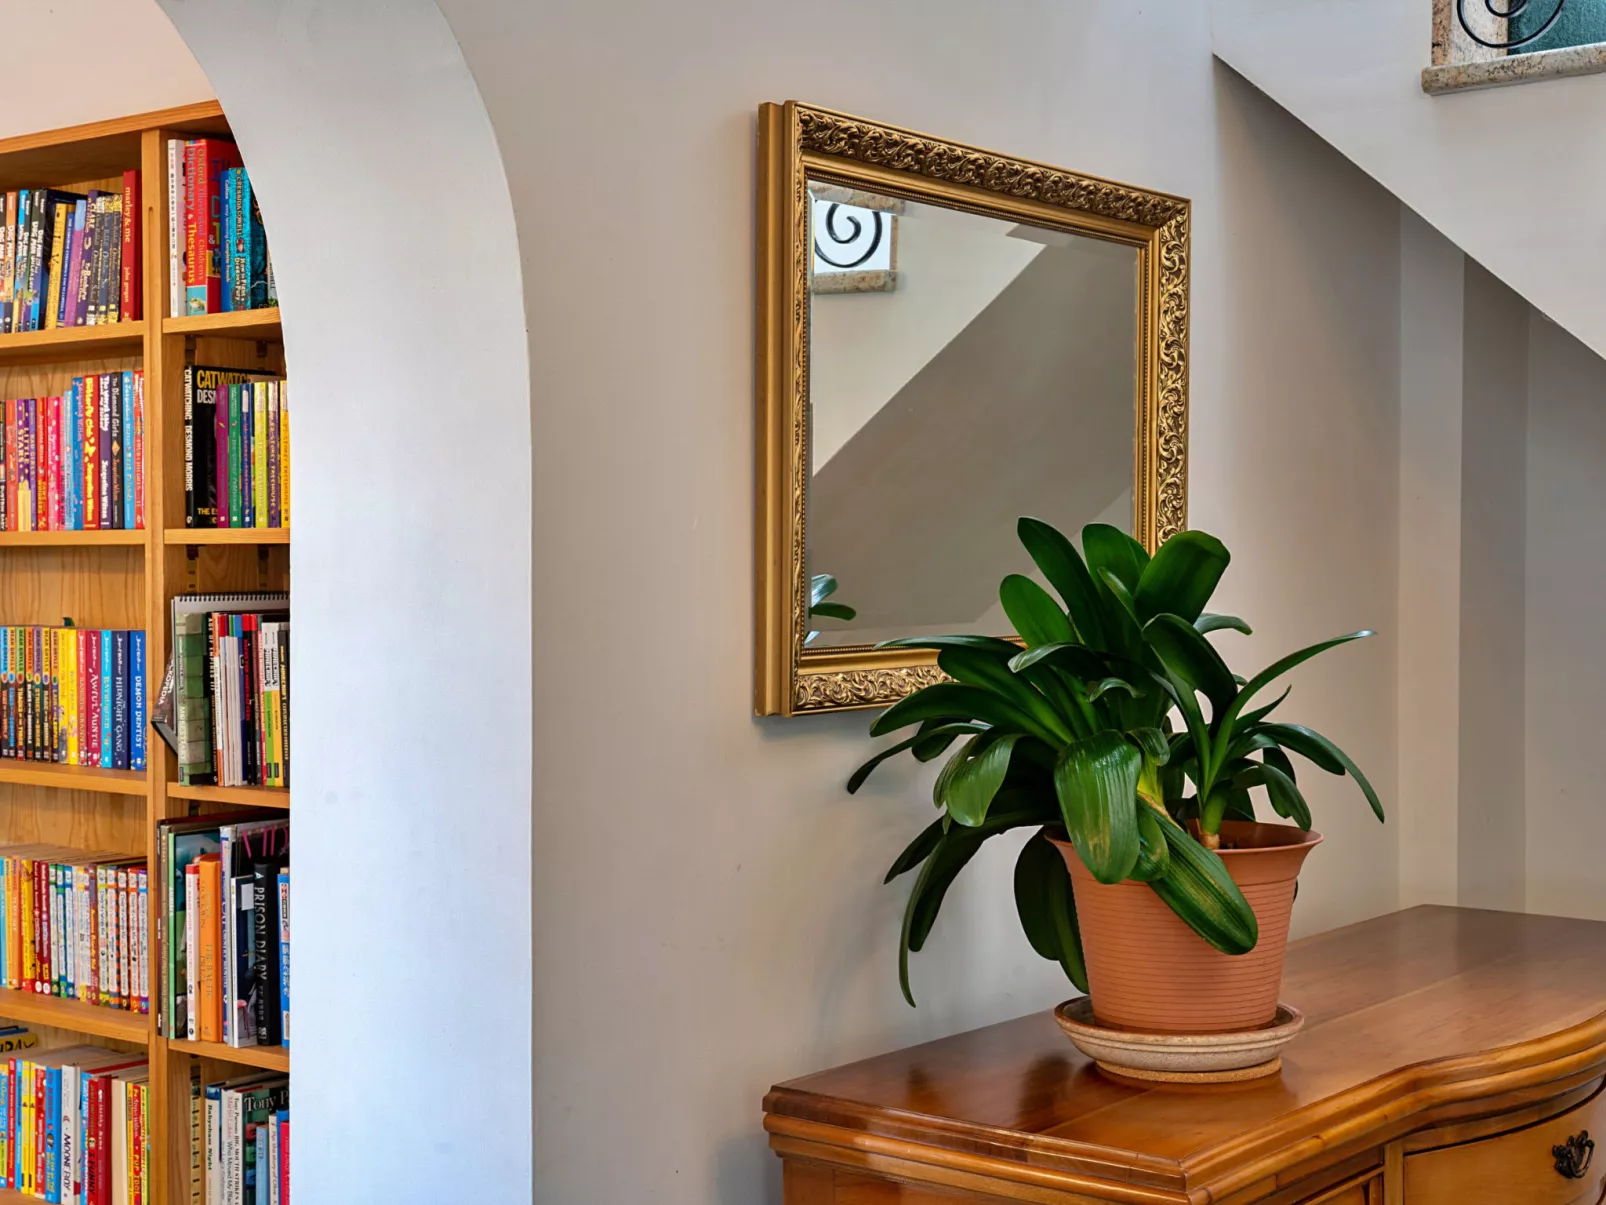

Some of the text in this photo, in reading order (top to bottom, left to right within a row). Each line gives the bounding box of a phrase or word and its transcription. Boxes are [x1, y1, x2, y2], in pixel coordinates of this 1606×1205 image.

[187, 147, 196, 210] Dictionary
[123, 187, 133, 243] marley & me
[198, 188, 206, 236] Illustrated
[188, 222, 197, 283] Thesaurus
[90, 674, 99, 709] AWFUL
[255, 887, 267, 980] PRISON DIARY
[244, 1096, 276, 1113] Tony
[226, 1180, 233, 1190] My
[272, 1169, 277, 1177] of
